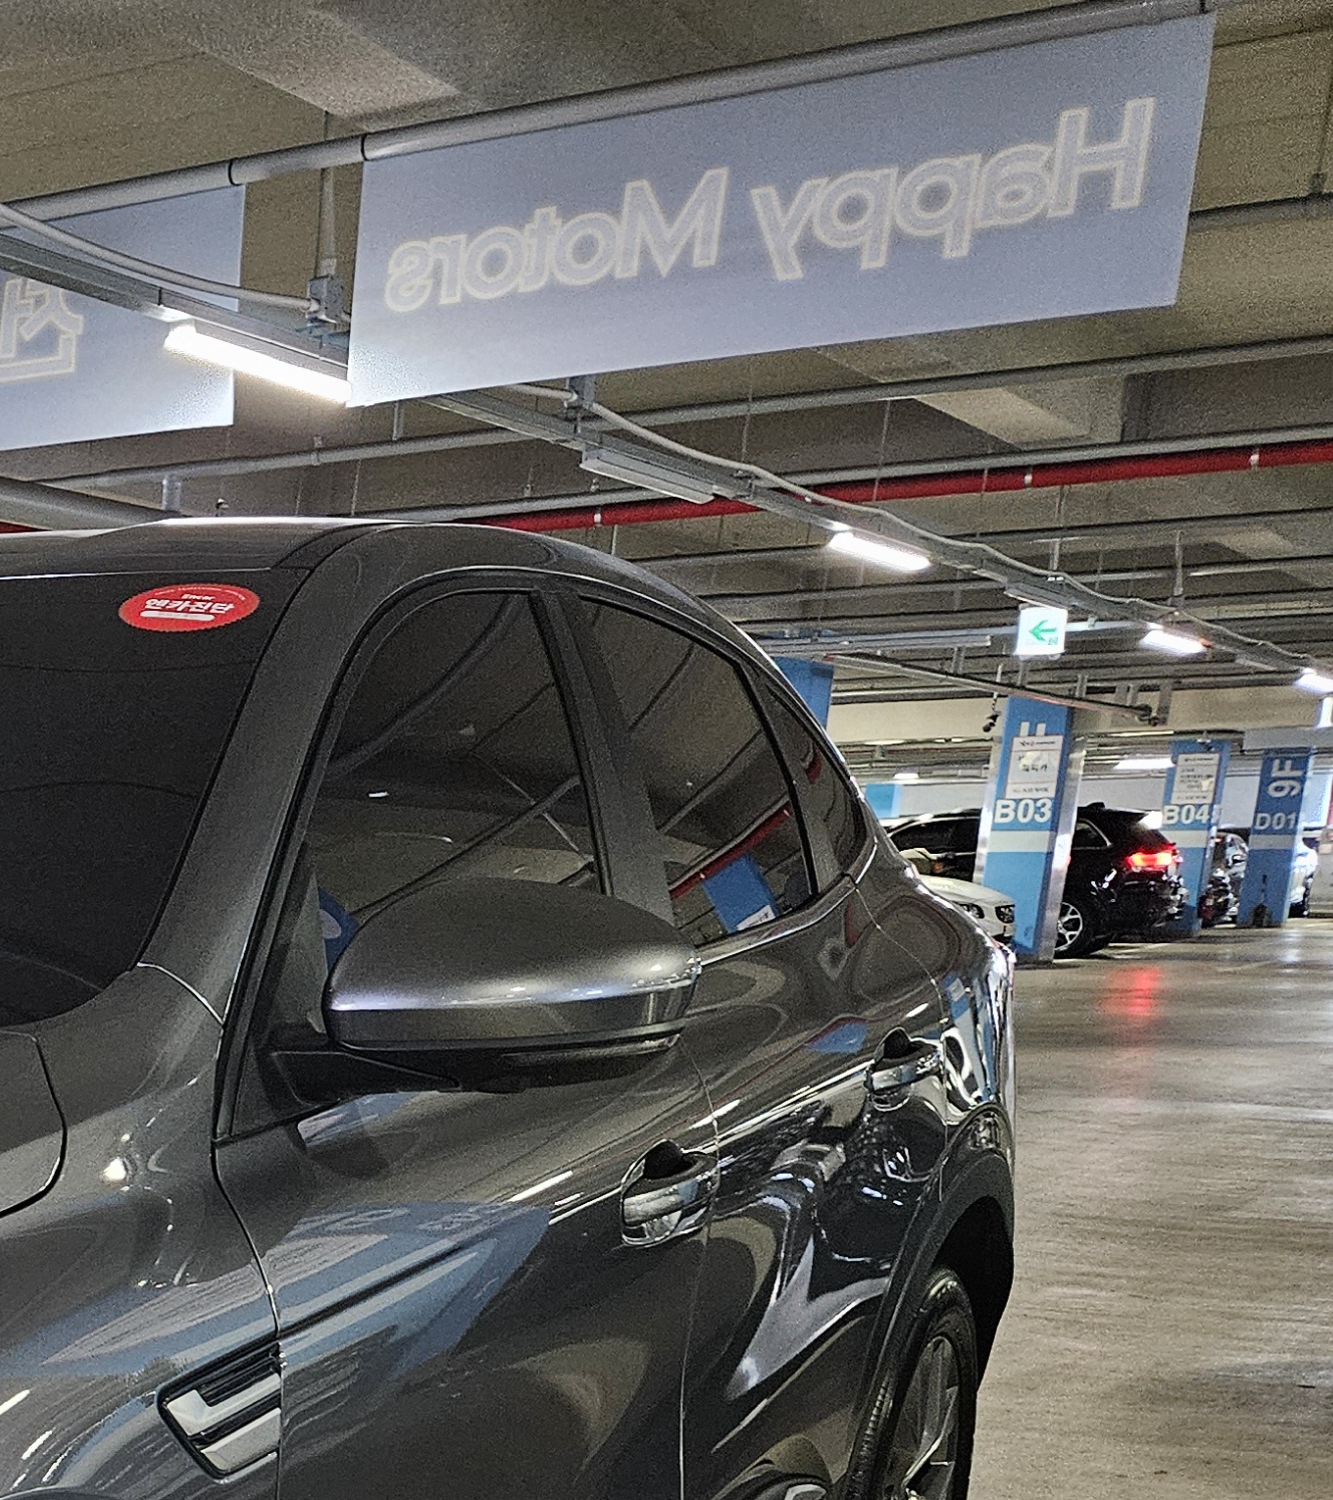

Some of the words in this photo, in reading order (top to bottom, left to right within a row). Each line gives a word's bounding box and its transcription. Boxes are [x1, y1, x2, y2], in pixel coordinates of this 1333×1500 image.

[1267, 758, 1304, 798] 9F
[994, 797, 1053, 824] B03
[1162, 803, 1210, 825] B04
[1255, 811, 1297, 831] D01
